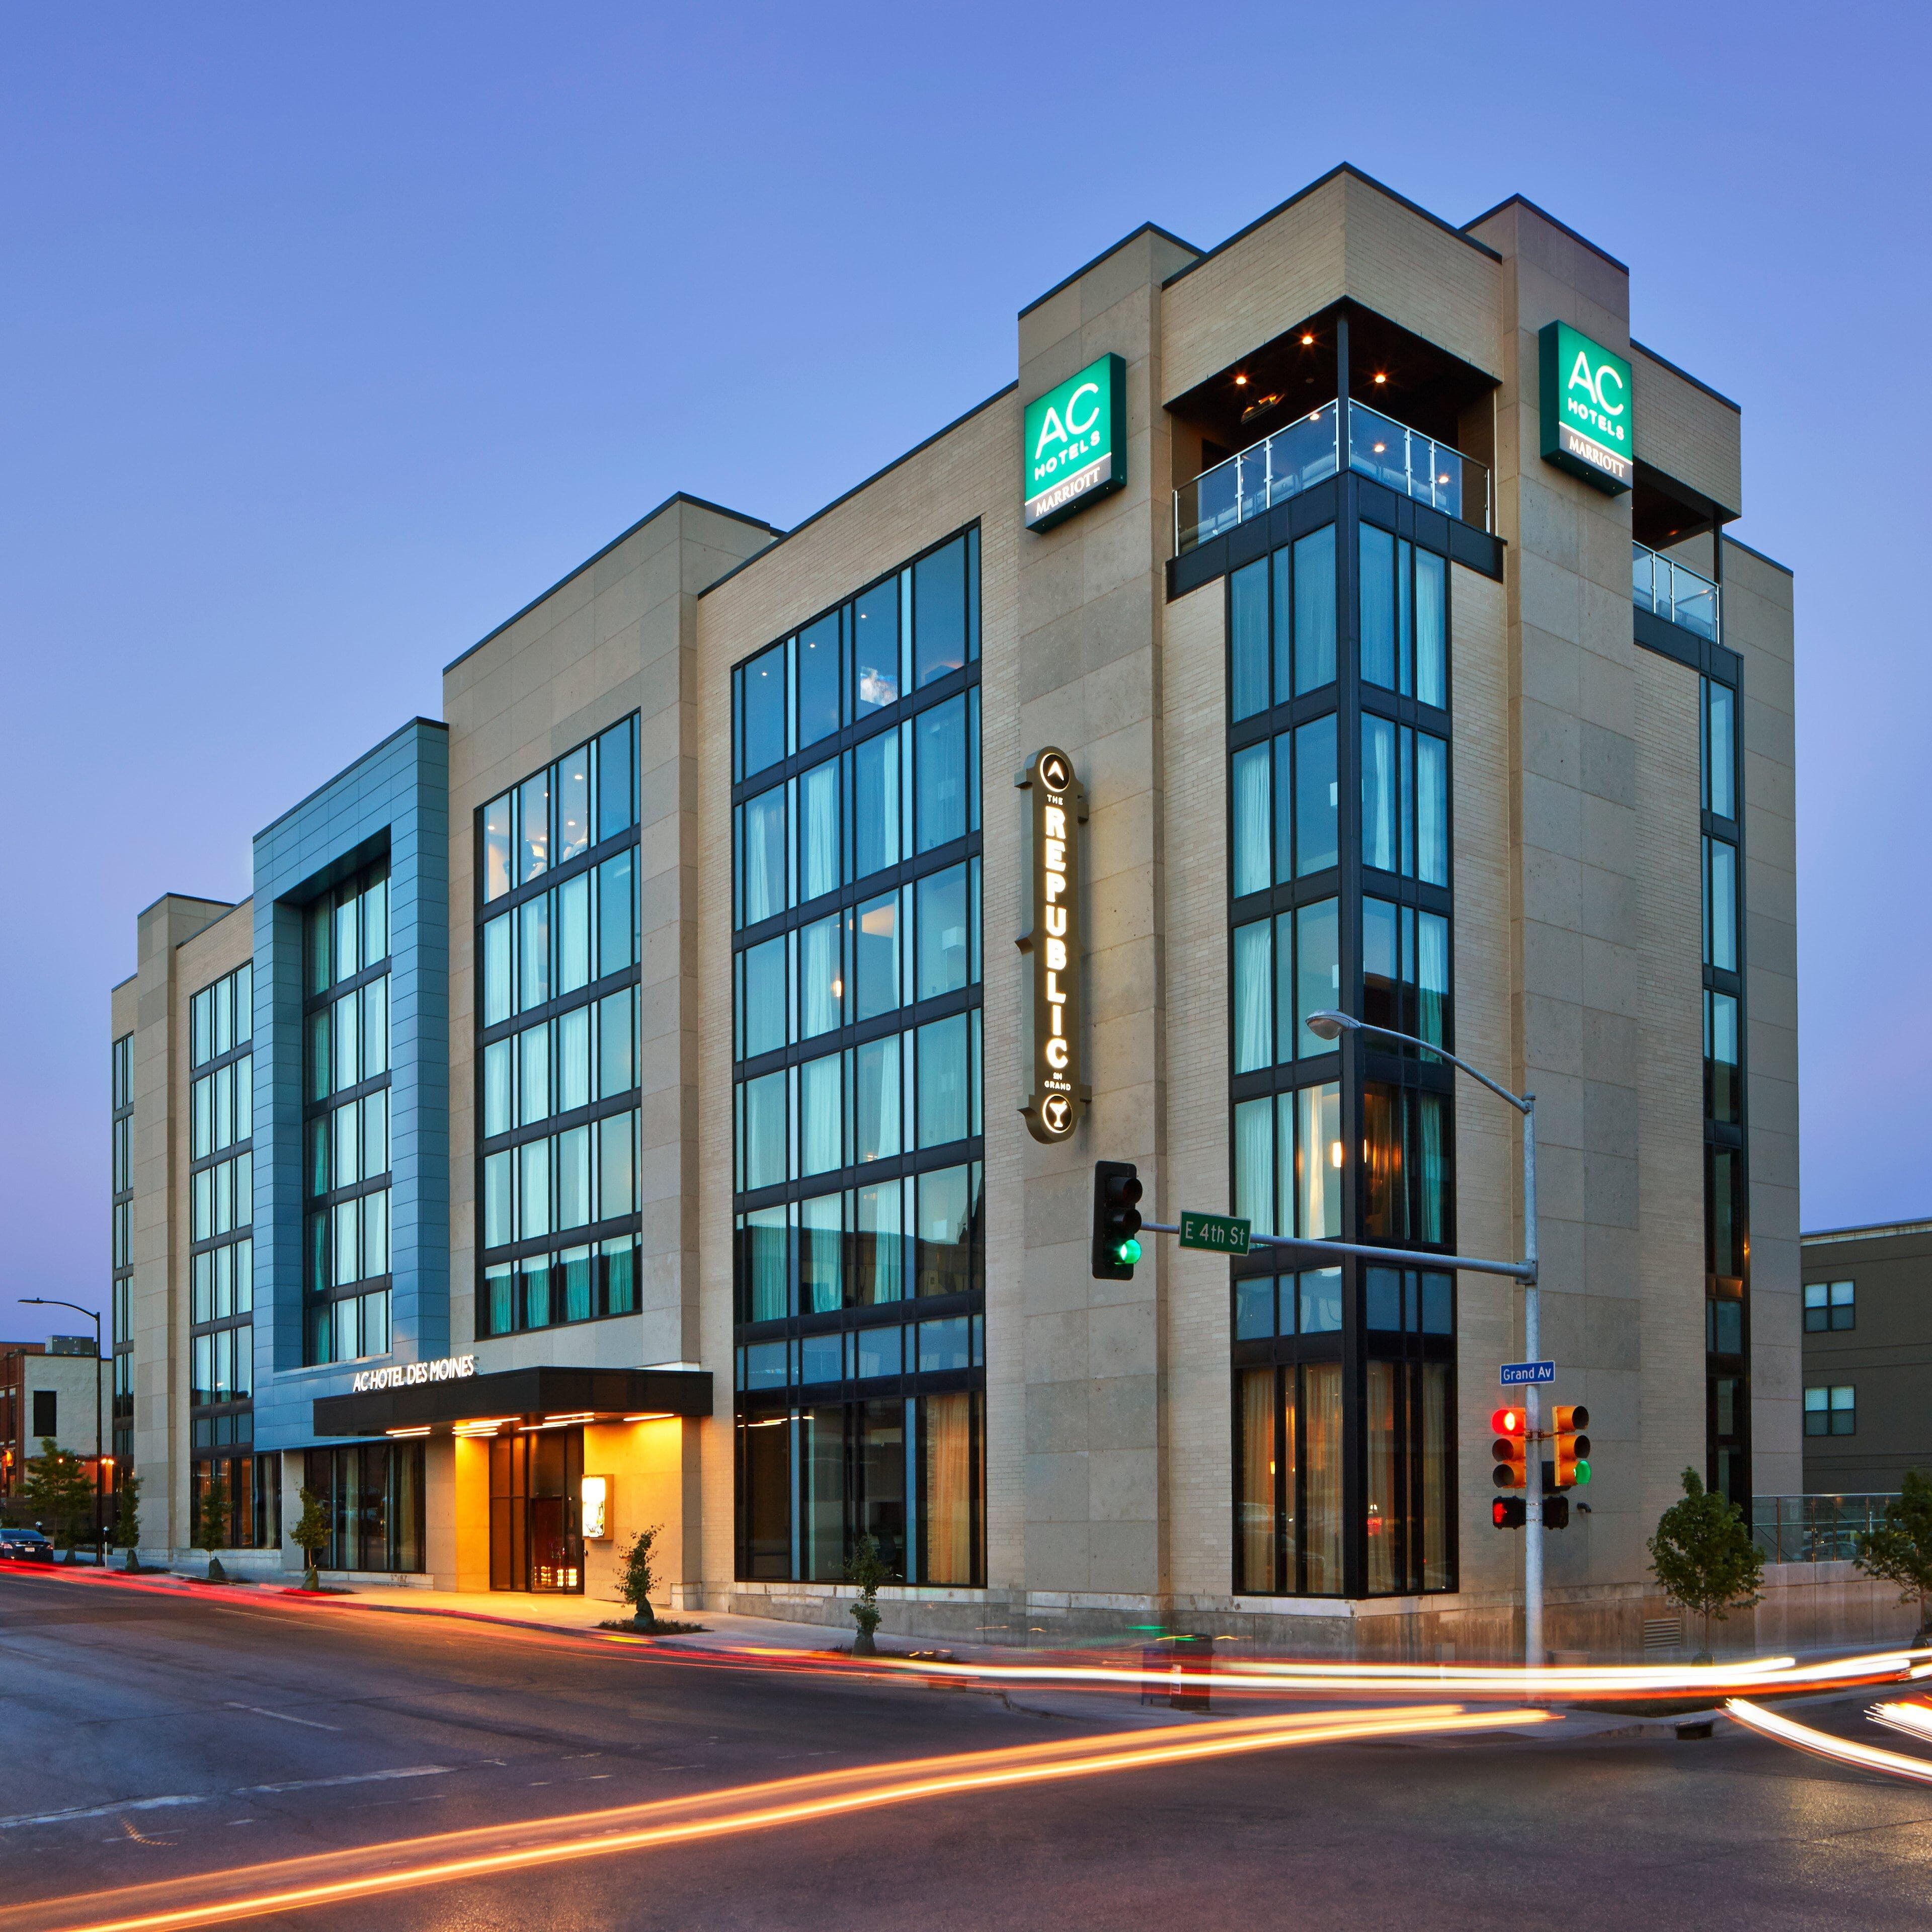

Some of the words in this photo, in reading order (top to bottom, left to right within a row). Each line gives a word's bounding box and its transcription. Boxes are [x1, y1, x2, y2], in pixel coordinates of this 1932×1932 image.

[1568, 351, 1624, 416] AC
[1035, 383, 1100, 460] AC
[1568, 397, 1625, 441] HOTELS
[1034, 430, 1100, 481] HOTELS
[1569, 435, 1625, 477] MARRIOTT
[1035, 466, 1100, 517] MARRIOTT
[1046, 794, 1063, 806] THE
[1045, 806, 1068, 1068] REPUBLIC
[1044, 1080, 1071, 1091] GRAND
[1185, 1221, 1194, 1240] E
[1199, 1223, 1225, 1244] 4th
[1230, 1226, 1245, 1246] St
[353, 1372, 369, 1392] AC
[370, 1366, 404, 1390] HOTEL
[407, 1361, 428, 1385] DES
[430, 1354, 474, 1382] MOINES
[1503, 1367, 1535, 1381] Grand
[1538, 1366, 1551, 1378] Av
